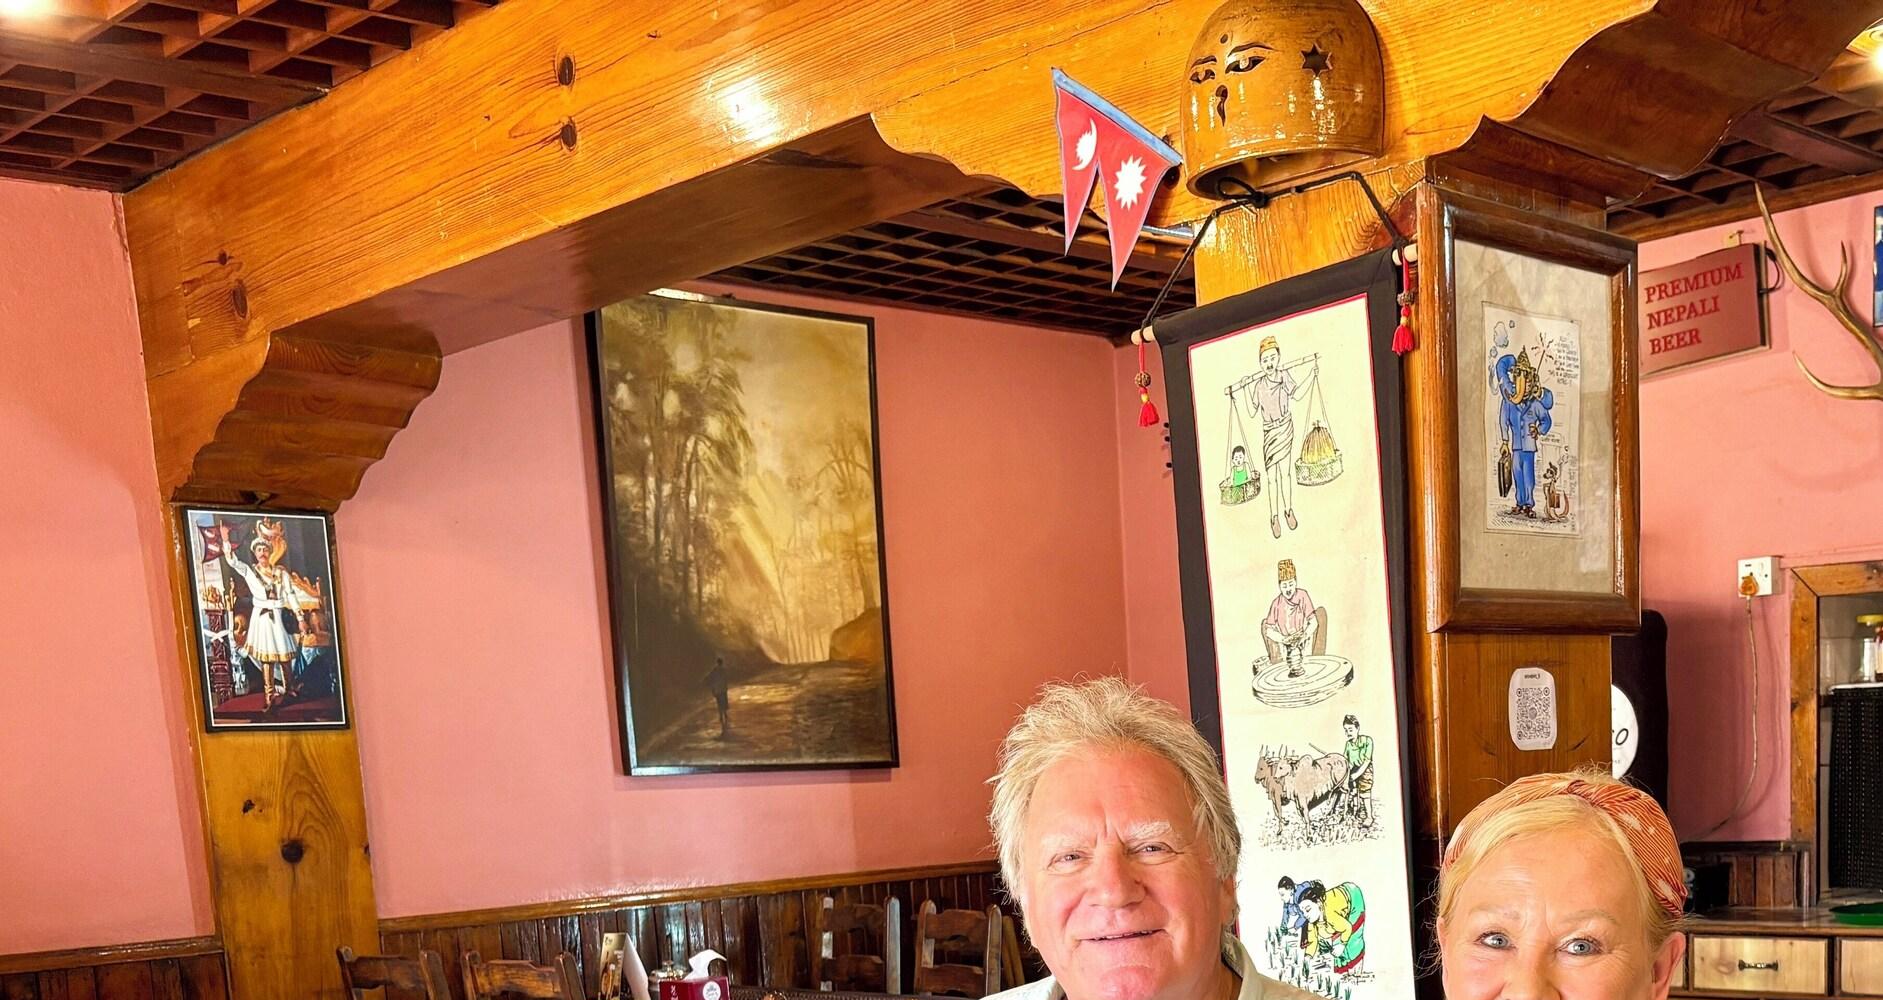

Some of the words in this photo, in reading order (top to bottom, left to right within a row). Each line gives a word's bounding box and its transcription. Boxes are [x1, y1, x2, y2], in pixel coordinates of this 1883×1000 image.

[1644, 262, 1744, 304] PREMIUM
[1646, 295, 1720, 330] NEPALI
[1649, 328, 1702, 355] BEER
